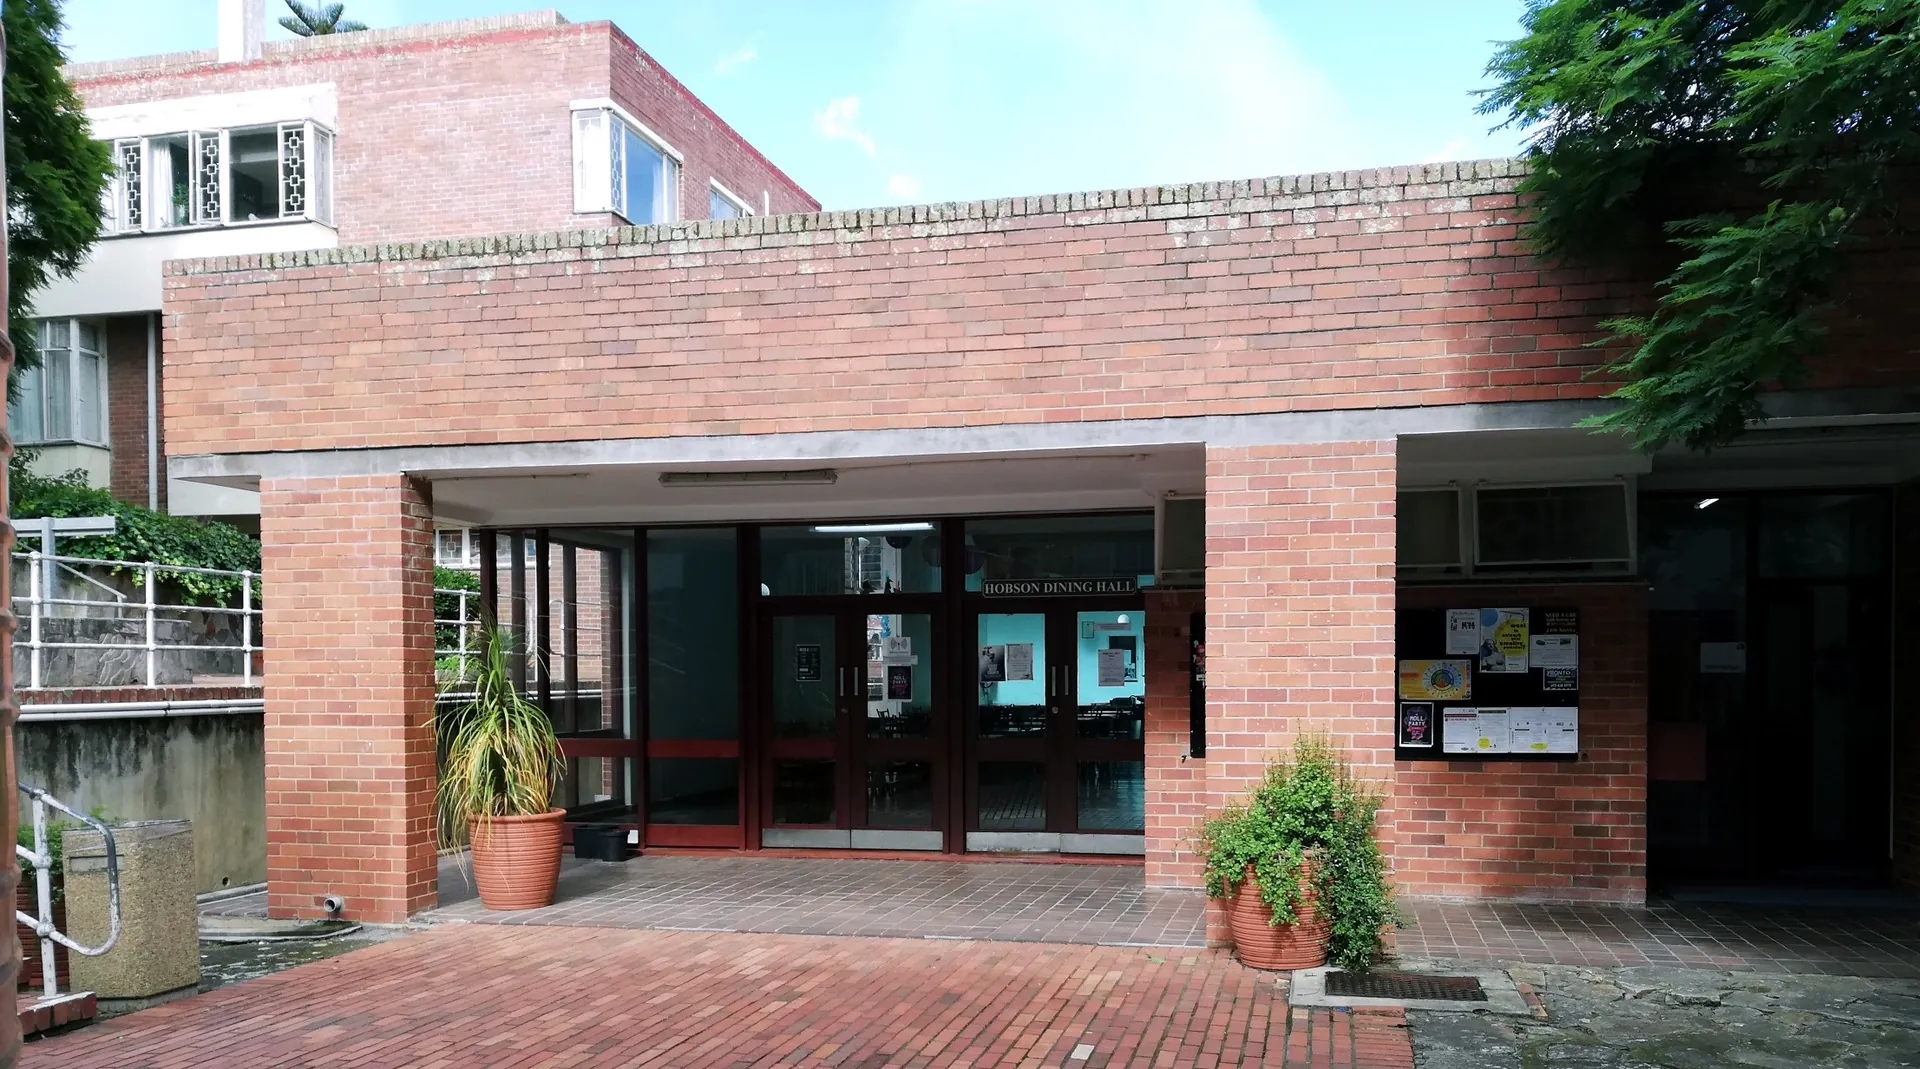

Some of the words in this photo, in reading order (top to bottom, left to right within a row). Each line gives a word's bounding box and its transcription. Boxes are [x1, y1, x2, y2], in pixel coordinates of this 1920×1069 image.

[984, 583, 1040, 594] HOBSON
[1044, 582, 1092, 593] DINING
[1097, 581, 1135, 592] HALL
